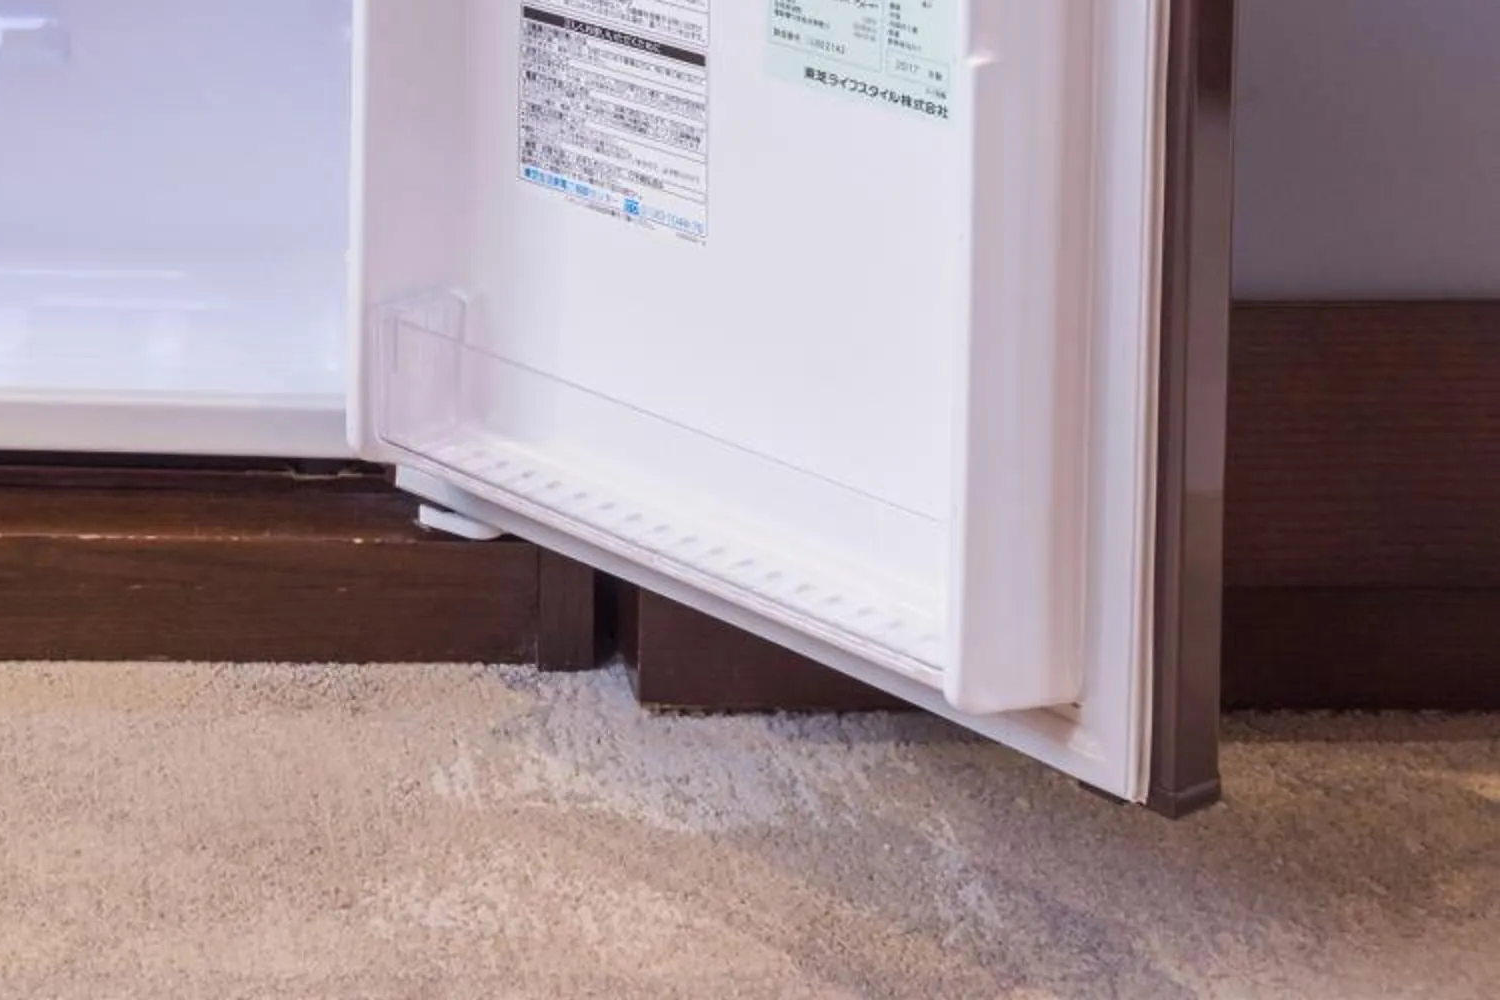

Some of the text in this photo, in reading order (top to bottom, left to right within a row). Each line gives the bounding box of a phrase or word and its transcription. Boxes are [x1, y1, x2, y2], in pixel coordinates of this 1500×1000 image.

[805, 67, 948, 119] 東芝ライフスタイル株式会社
